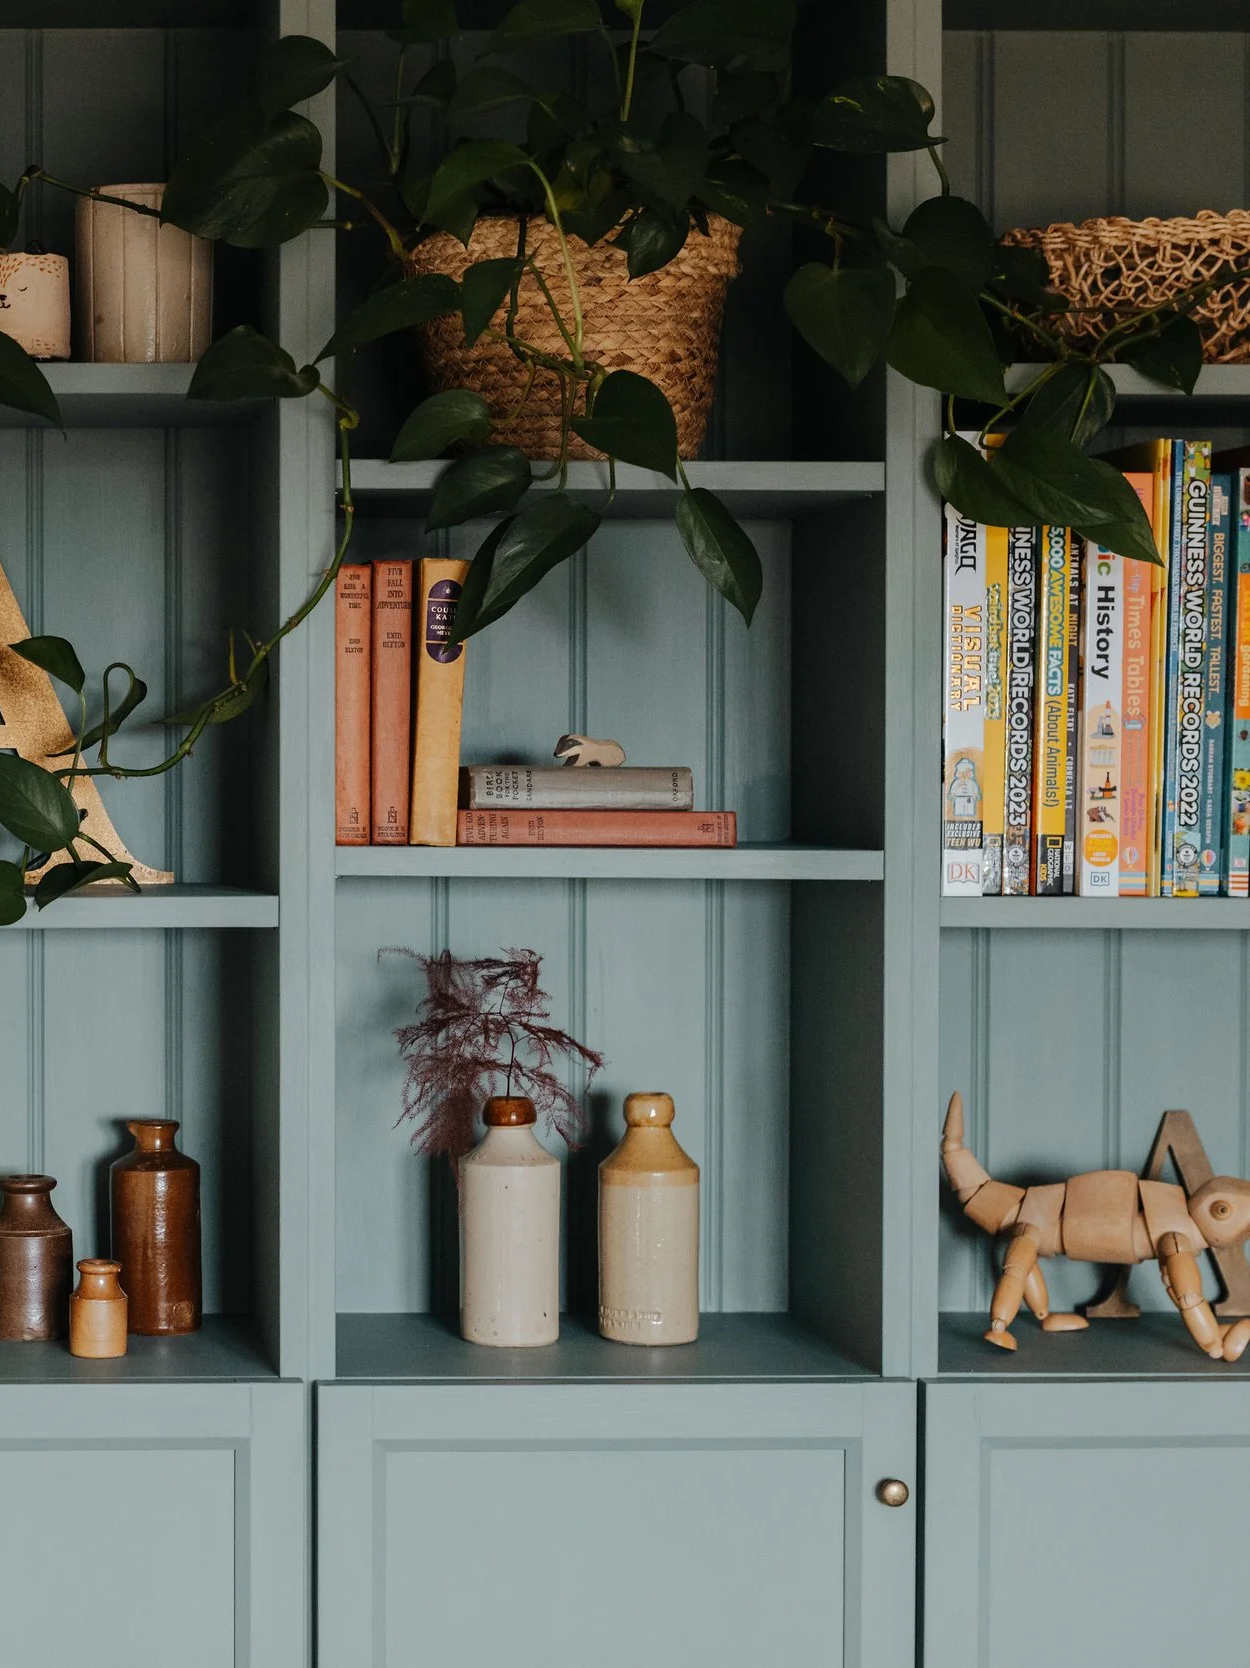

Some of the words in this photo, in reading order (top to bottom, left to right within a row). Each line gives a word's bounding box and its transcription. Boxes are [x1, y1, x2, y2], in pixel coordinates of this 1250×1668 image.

[1048, 527, 1064, 568] 5,000
[1186, 480, 1206, 586] GUINNESS
[1213, 532, 1224, 584] BIGGEST.
[388, 568, 402, 576] FIVE
[1070, 543, 1078, 586] ANIMALS
[388, 590, 403, 598] INTO
[1048, 569, 1064, 648] AWESOME
[1070, 594, 1078, 606] AT
[1211, 590, 1223, 640] FASTEST.
[1013, 589, 1032, 672] WORLD
[1070, 614, 1078, 646] NIGHT
[1091, 586, 1115, 680] History
[1128, 594, 1145, 648] Times
[1184, 589, 1204, 668] WORLD
[950, 605, 962, 712] DICTIONARY
[964, 605, 981, 711] VISUAL
[1048, 650, 1064, 696] FACTS
[988, 686, 1000, 718] 2023
[1127, 656, 1144, 716] Tables
[1010, 673, 1029, 772] RECORDS
[1045, 700, 1061, 744] (About
[1180, 672, 1201, 771] RECORDS
[1010, 775, 1027, 826] 2023
[1045, 746, 1061, 808] Animals!)
[1180, 776, 1200, 826] 2022
[466, 813, 473, 823] GO
[947, 838, 964, 846] TEEN
[967, 838, 980, 846] WU
[950, 863, 976, 880] DK
